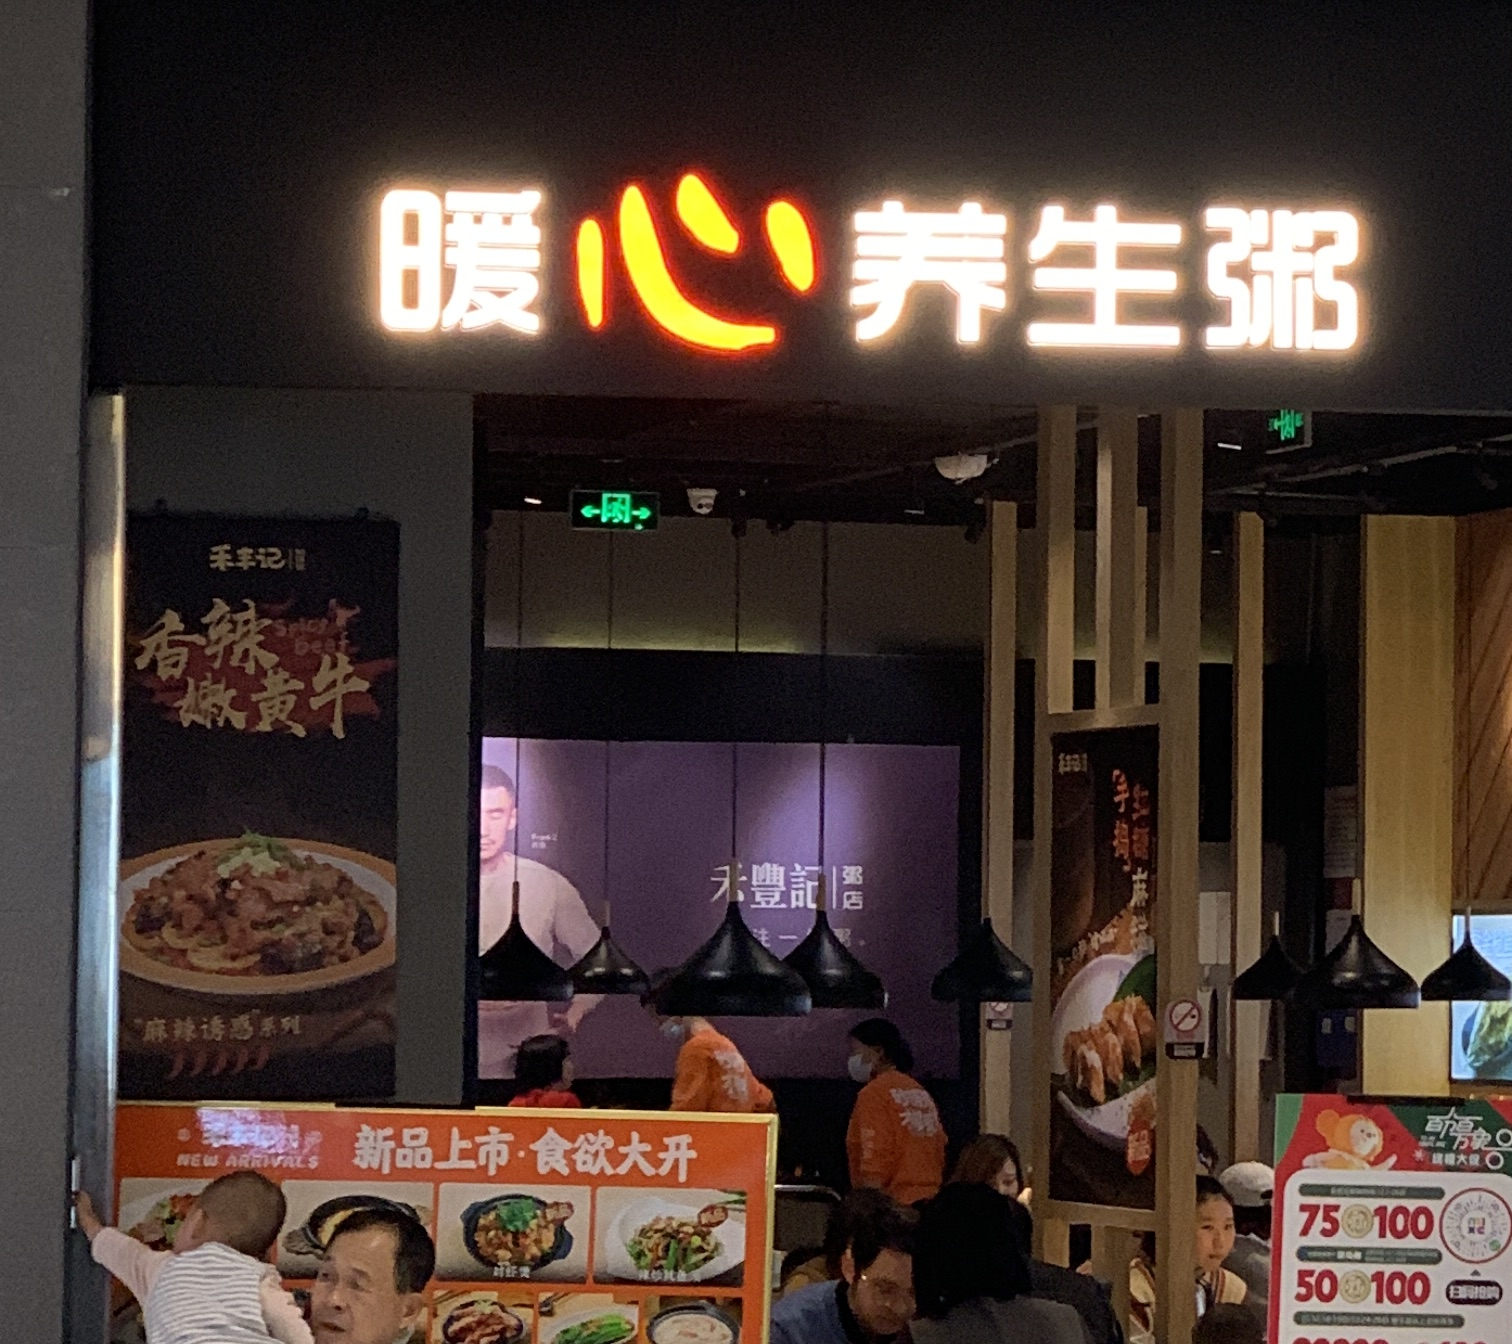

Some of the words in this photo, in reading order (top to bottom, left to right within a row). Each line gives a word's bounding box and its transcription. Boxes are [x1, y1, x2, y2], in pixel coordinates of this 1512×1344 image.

[379, 172, 1359, 351] 暖心养生粥
[175, 652, 370, 739] 嫩黄牛
[176, 1153, 219, 1168] NEW
[1299, 1204, 1341, 1238] 75
[1373, 1205, 1435, 1240] 100
[1295, 1269, 1338, 1303] 50
[1371, 1271, 1431, 1305] 100
